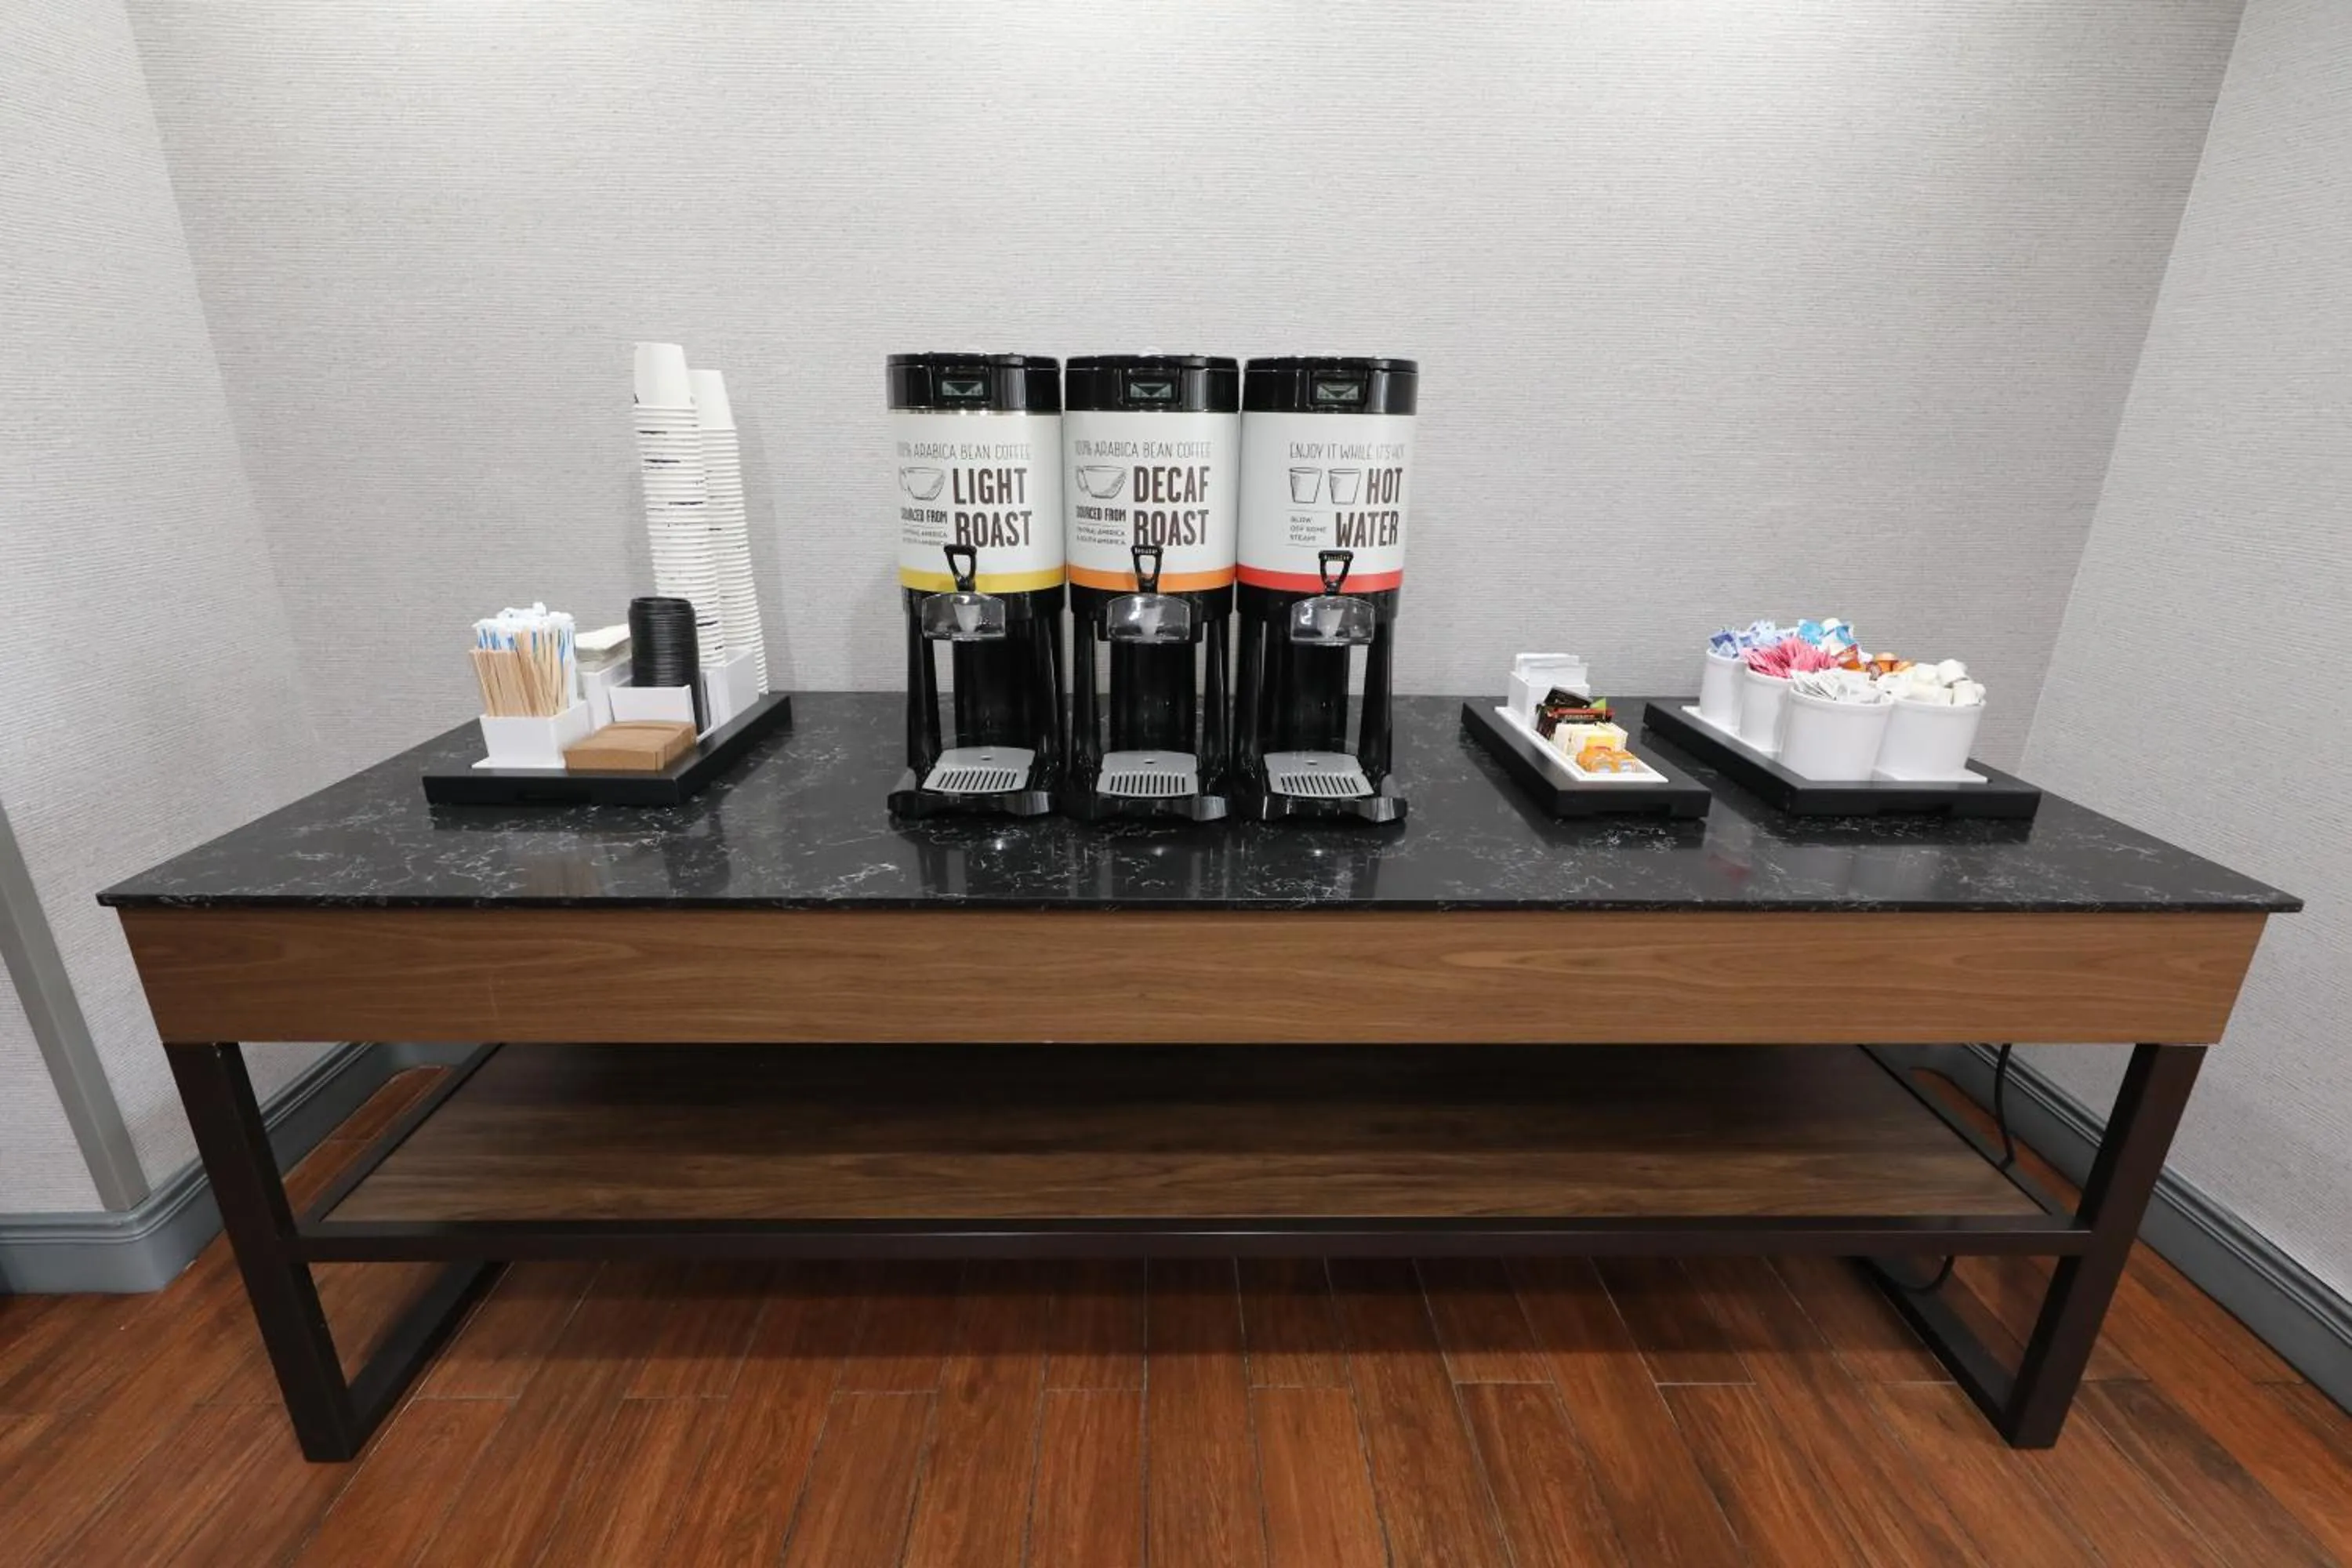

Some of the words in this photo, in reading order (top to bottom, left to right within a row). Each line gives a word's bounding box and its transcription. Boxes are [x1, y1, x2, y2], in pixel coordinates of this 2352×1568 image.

[914, 443, 956, 459] ARABICA
[960, 443, 991, 460] BEAN
[1094, 441, 1138, 459] ARABICA
[1144, 441, 1173, 459] BEAN
[1290, 442, 1324, 459] ENJOY
[1327, 442, 1338, 460] IT
[1340, 443, 1374, 461] WHILE
[953, 467, 1028, 505] LIGHT
[1134, 466, 1210, 503] DECAF
[1367, 467, 1403, 505] HOT
[955, 510, 1033, 547] ROAST
[1105, 507, 1127, 522] FROM
[1134, 508, 1210, 546] ROAST
[1336, 510, 1399, 548] WATER
